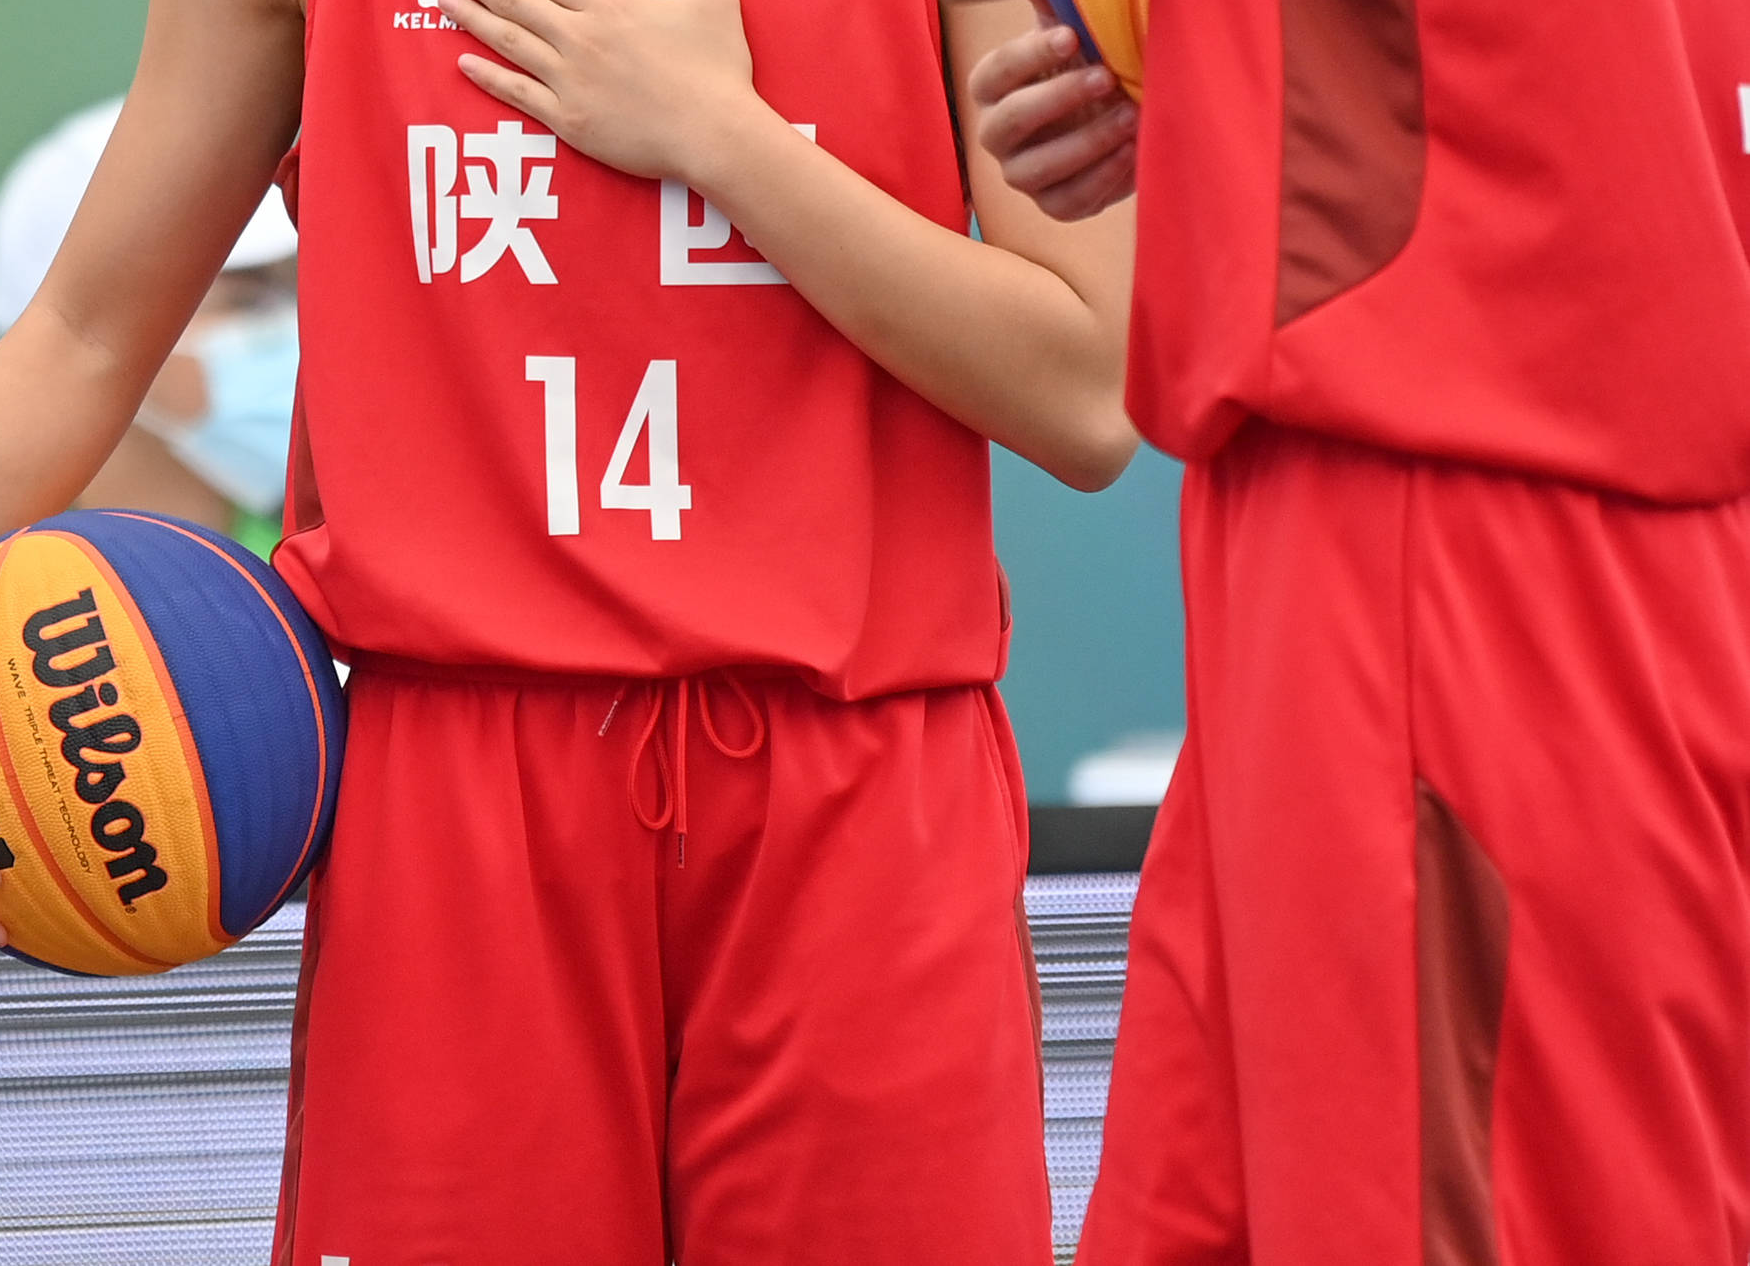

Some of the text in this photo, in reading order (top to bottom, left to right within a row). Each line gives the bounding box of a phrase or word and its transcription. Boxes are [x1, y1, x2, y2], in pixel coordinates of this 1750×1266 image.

[393, 12, 458, 30] KELM
[525, 355, 692, 540] 14
[7, 657, 93, 875] WAVE TRIPLE THREAT TECHNOLOGY
[22, 587, 169, 908] Wilson
